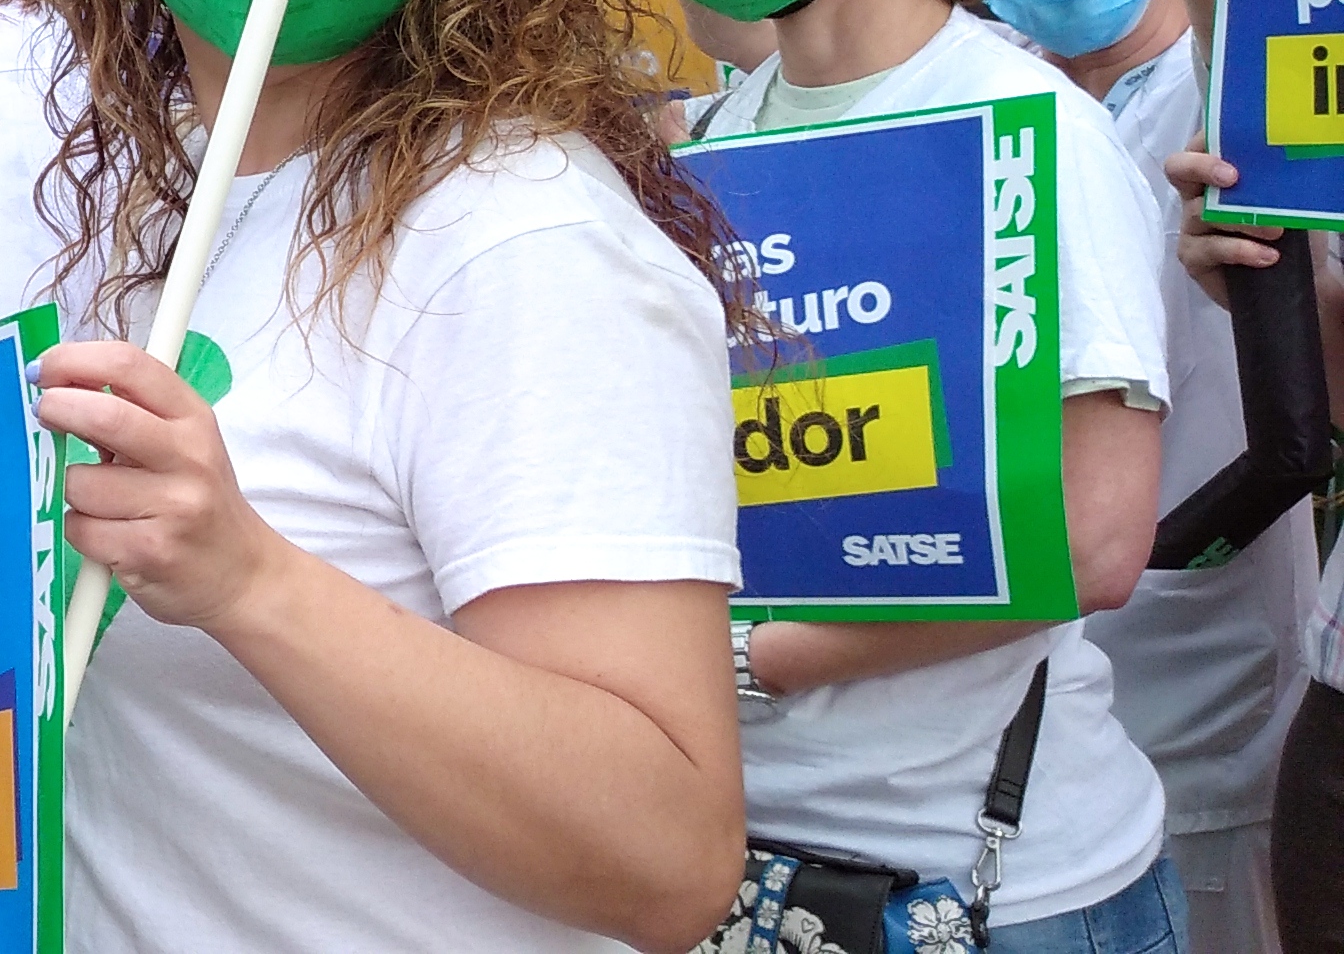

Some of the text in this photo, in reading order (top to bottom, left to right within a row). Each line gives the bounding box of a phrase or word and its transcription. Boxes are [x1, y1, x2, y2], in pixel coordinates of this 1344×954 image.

[994, 126, 1038, 369] SATSE
[733, 395, 881, 474] dor
[841, 532, 964, 567] SATSE
